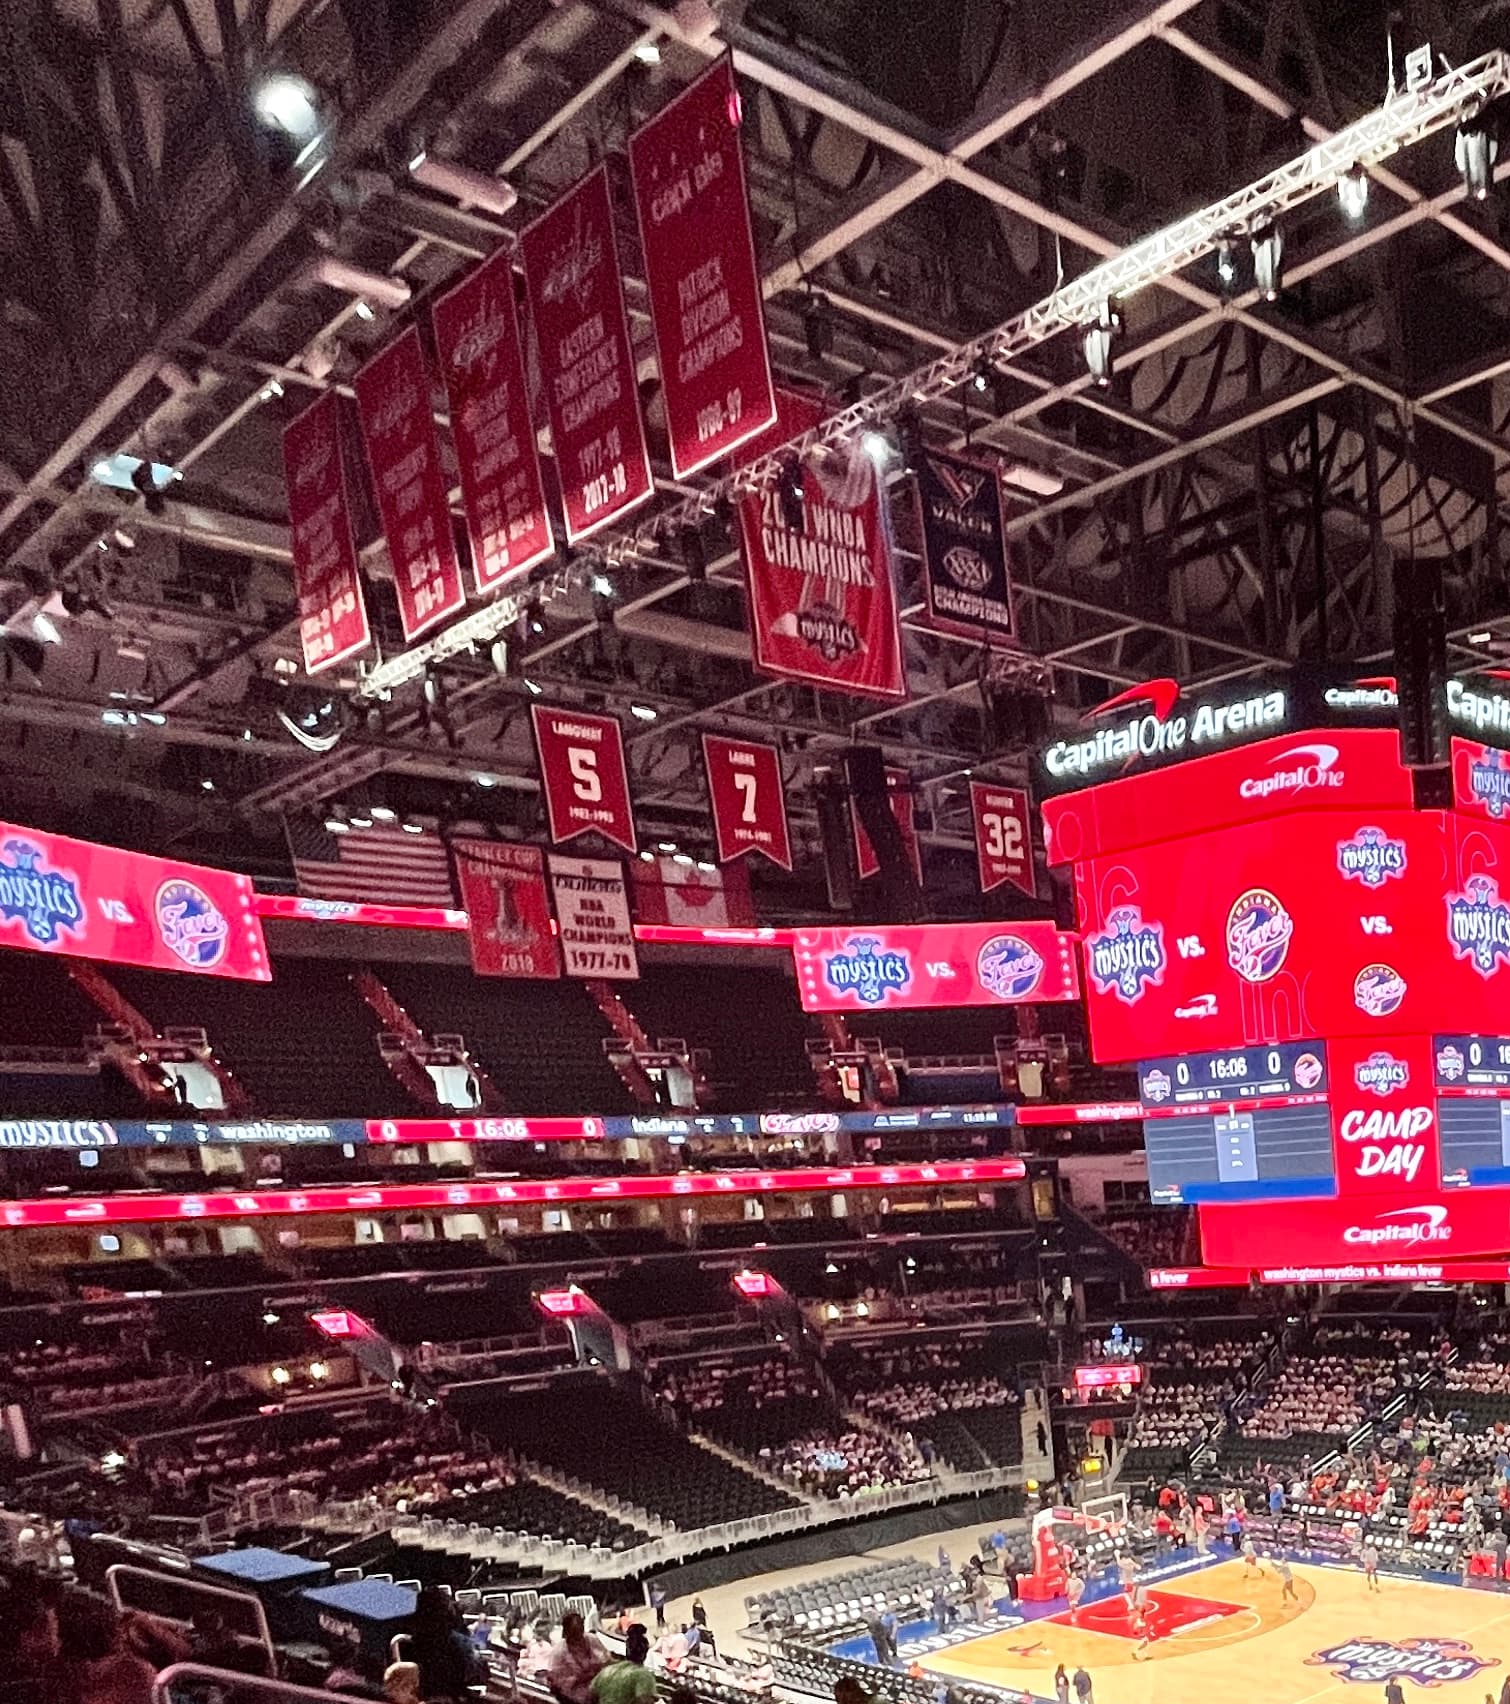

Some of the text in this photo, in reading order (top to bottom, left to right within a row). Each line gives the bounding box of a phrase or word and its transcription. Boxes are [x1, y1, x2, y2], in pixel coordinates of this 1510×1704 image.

[812, 504, 867, 550] WNBA
[762, 527, 876, 587] CHAMPIONS
[1191, 692, 1286, 742] Arena
[568, 747, 602, 802] 5
[734, 773, 757, 823] 7
[982, 813, 1025, 860] 32
[1342, 847, 1402, 869] mystics
[563, 928, 632, 946] CHAMPIONS
[829, 958, 907, 983] mystics
[1096, 940, 1160, 976] mystics
[1176, 1051, 1281, 1085] 0 16:06 0
[1469, 1043, 1482, 1066] 0
[219, 1122, 331, 1143] washington
[381, 1121, 397, 1140] 0
[474, 1119, 528, 1139] 16:06
[582, 1118, 596, 1137] 0
[1341, 1106, 1434, 1142] CAMP
[1354, 1143, 1426, 1182] DAY
[1263, 1266, 1322, 1280] washington
[1324, 1265, 1364, 1280] mystics
[1327, 1643, 1476, 1680] mystics
